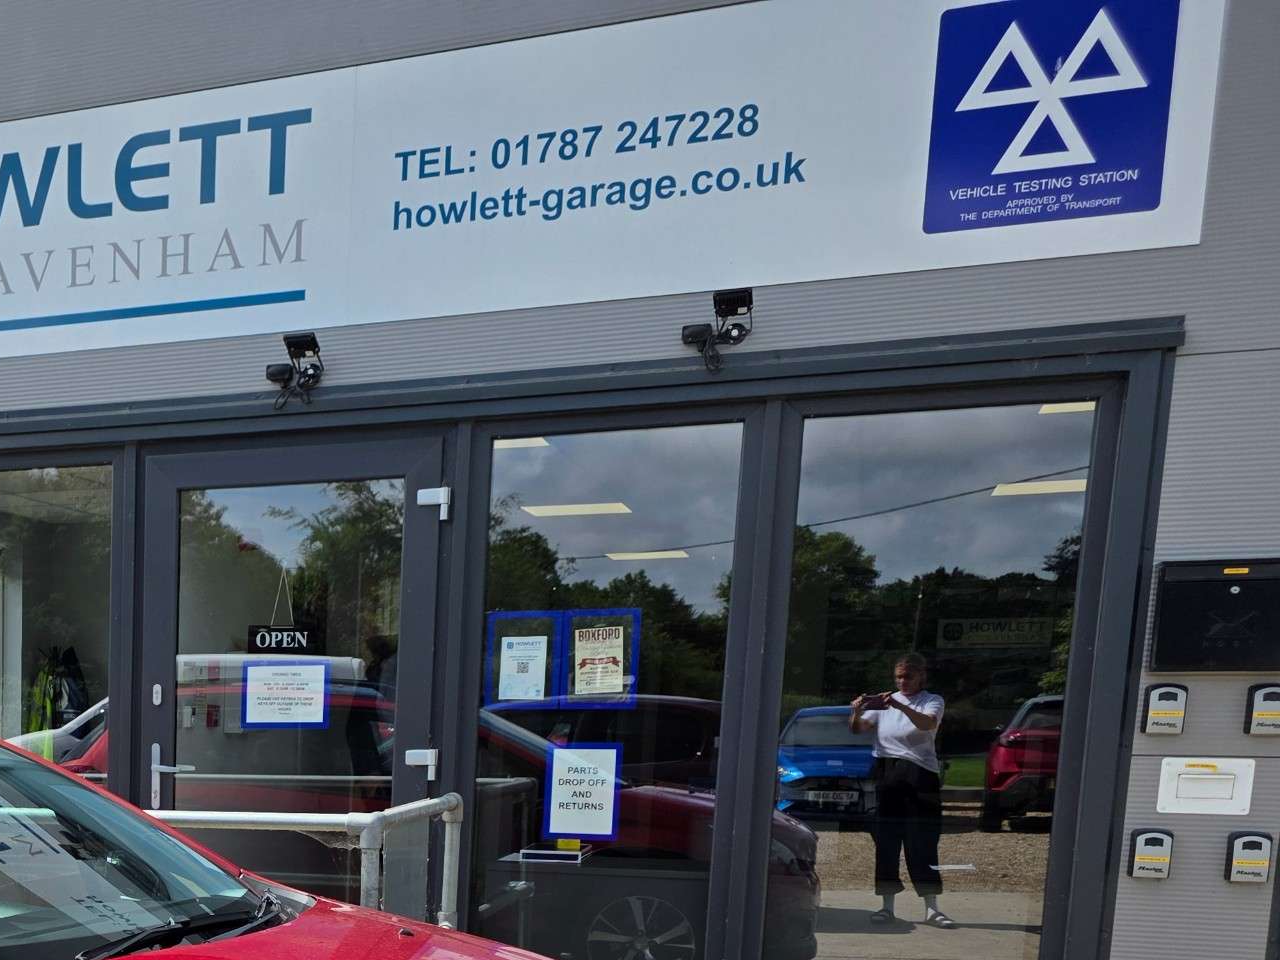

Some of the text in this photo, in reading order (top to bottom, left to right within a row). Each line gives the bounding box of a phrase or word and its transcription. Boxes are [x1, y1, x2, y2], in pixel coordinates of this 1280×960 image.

[394, 103, 760, 181] TEL: 01787 247228
[392, 151, 808, 231] howlett-garage.co.uk
[949, 168, 1139, 201] VEHICLE TESTING STATION
[1006, 193, 1074, 208] APPROVED BY
[960, 197, 1122, 222] THE DEPARTMENT OF TRANSPORT
[255, 631, 308, 648] OPEN
[578, 628, 621, 642] BOXFORD
[567, 766, 599, 775] PARTS
[558, 778, 607, 787] DROP OFF
[571, 790, 592, 799] AND
[558, 802, 604, 811] RETURNS
